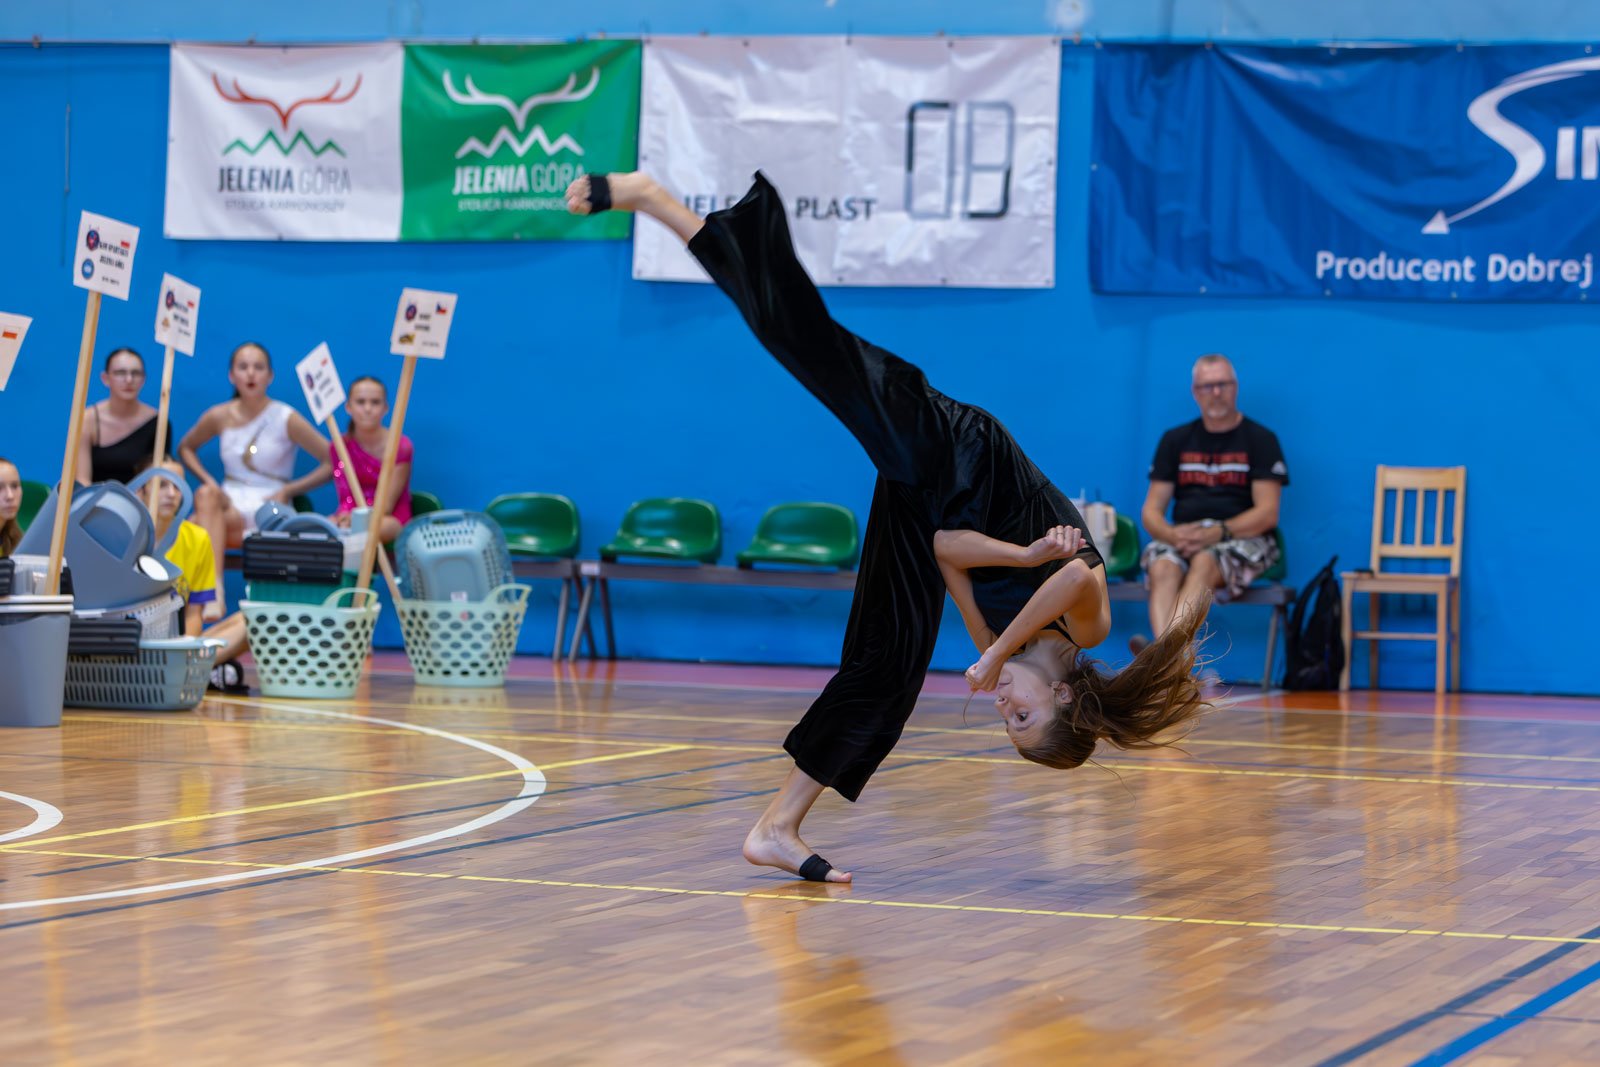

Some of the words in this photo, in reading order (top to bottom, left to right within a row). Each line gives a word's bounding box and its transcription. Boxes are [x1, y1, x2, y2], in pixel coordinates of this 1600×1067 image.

[218, 166, 294, 193] JELENIA
[300, 165, 351, 194] GÓRA
[452, 164, 528, 195] JELENIA
[796, 196, 878, 220] PLAST
[1315, 250, 1476, 282] Producent
[1487, 252, 1593, 289] Dobrej
